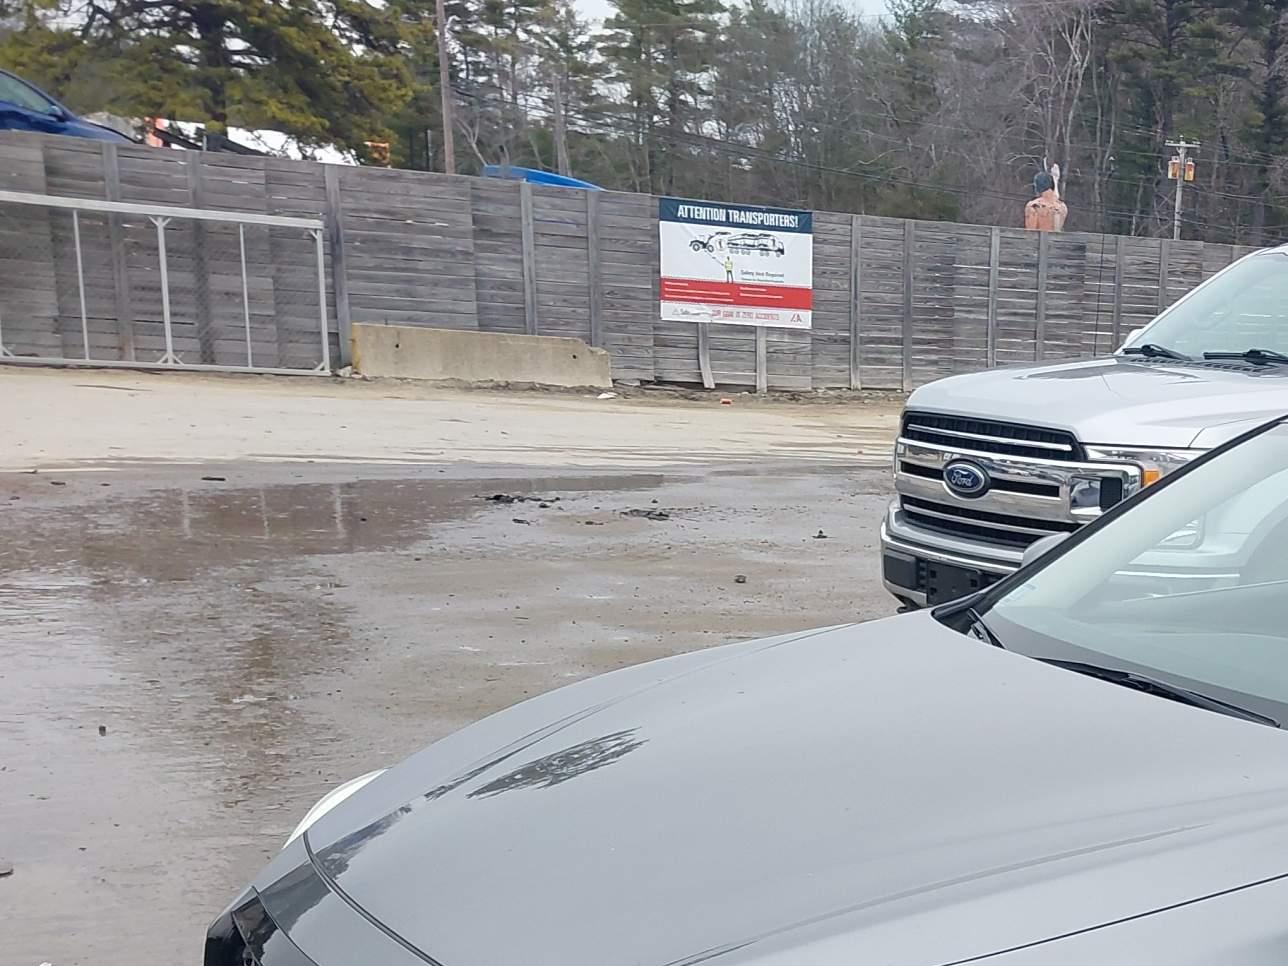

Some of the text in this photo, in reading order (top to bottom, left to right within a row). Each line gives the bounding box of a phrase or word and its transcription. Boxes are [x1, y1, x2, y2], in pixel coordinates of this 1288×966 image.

[677, 205, 799, 228] ATTENTION TRANSPORTERS!
[951, 469, 975, 487] Ford
